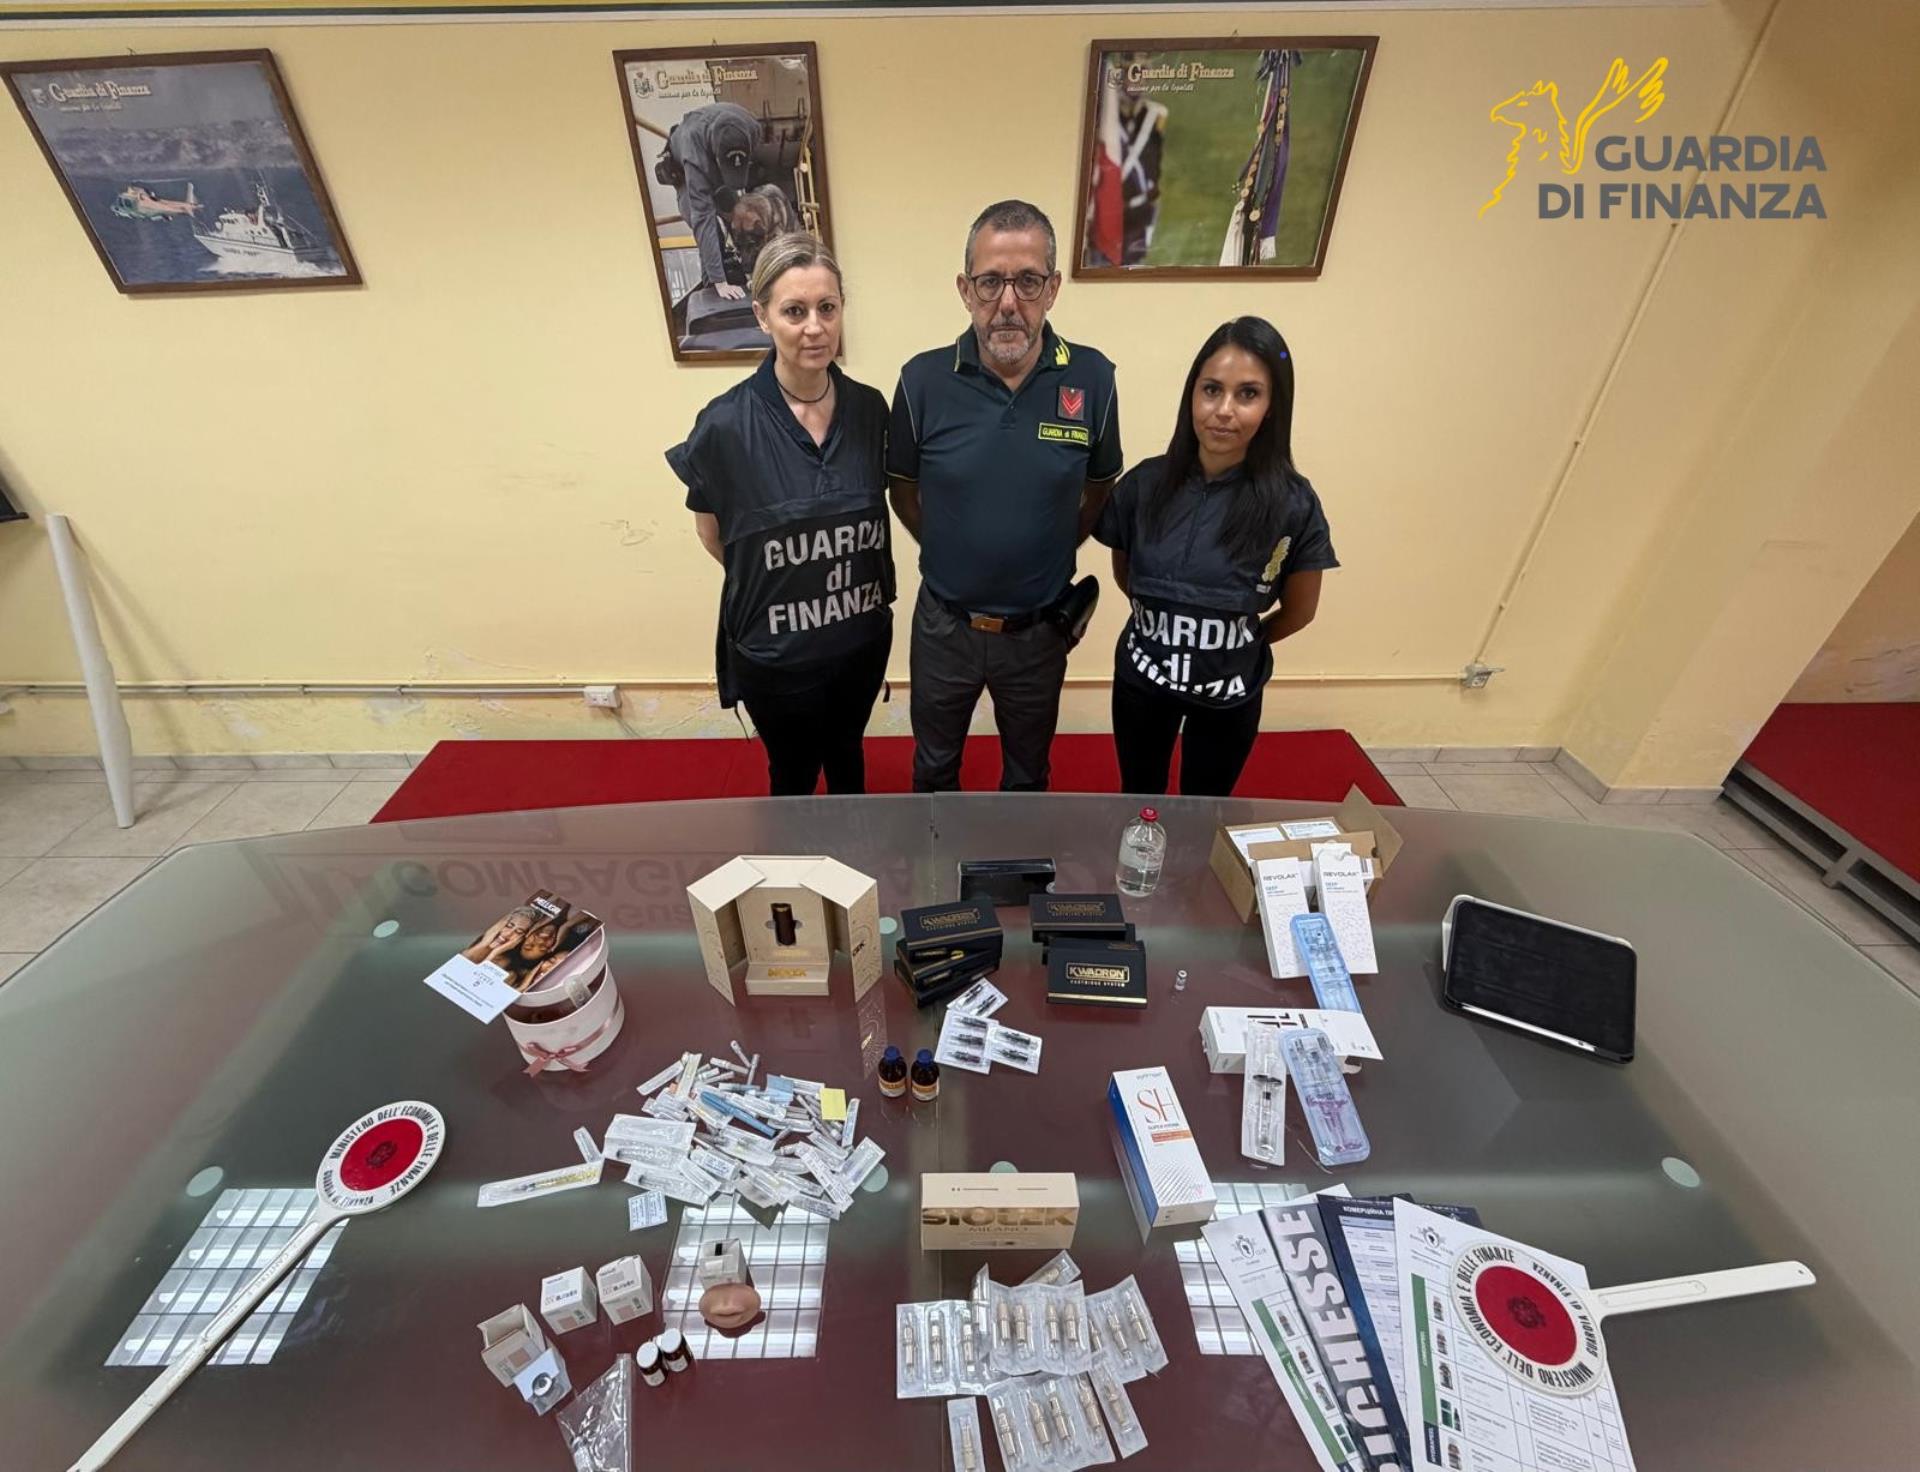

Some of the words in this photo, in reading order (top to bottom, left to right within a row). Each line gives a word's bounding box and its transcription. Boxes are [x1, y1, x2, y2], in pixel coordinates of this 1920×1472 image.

[712, 65, 758, 86] Finanza
[1127, 63, 1175, 83] Guardia
[1177, 63, 1187, 78] di
[1188, 62, 1235, 81] Finanza
[1042, 427, 1063, 438] GUARDIA
[826, 560, 852, 592] di
[768, 579, 882, 635] FINANZA
[1162, 653, 1191, 682] di
[1263, 872, 1298, 881] REVOLAX
[1069, 966, 1124, 980] KWADRON
[401, 1105, 436, 1126] ECONOMIA
[1137, 1086, 1180, 1124] SH
[329, 1117, 374, 1160] MINISTERO
[421, 1130, 440, 1158] DELLE
[389, 1160, 427, 1195] FINANZE
[1472, 1245, 1515, 1264] FINANZE
[1456, 1255, 1478, 1284] DELLE
[1531, 1262, 1573, 1298] FINANZA
[1456, 1284, 1471, 1293] E
[1459, 1295, 1503, 1353] ECONOMIA
[1578, 1314, 1598, 1358] GUARDIA
[1538, 1361, 1594, 1388] MINISTERO
